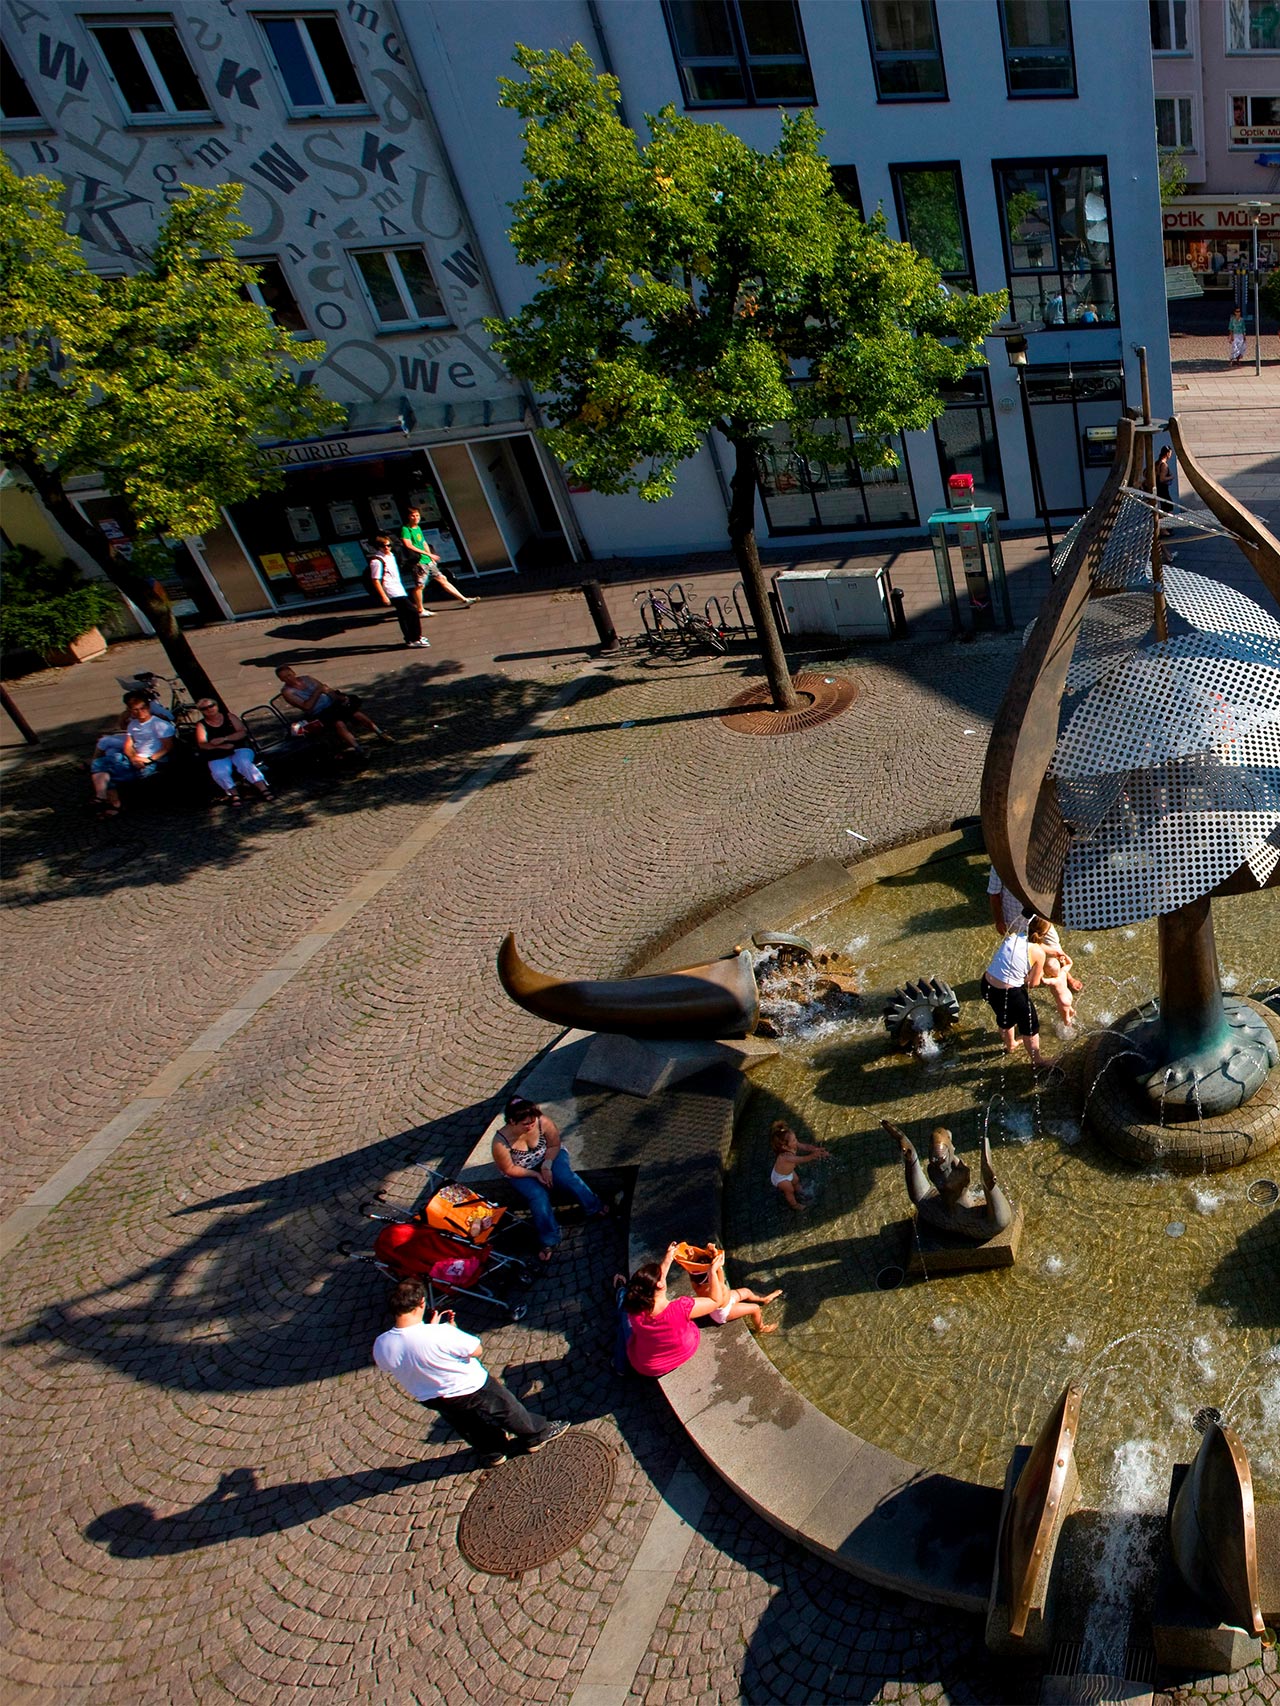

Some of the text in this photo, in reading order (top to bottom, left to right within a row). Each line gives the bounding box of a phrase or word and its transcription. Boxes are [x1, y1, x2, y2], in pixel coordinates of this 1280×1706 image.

[1240, 128, 1265, 137] Optik
[1164, 210, 1205, 229] ptik
[1217, 210, 1280, 226] Müler
